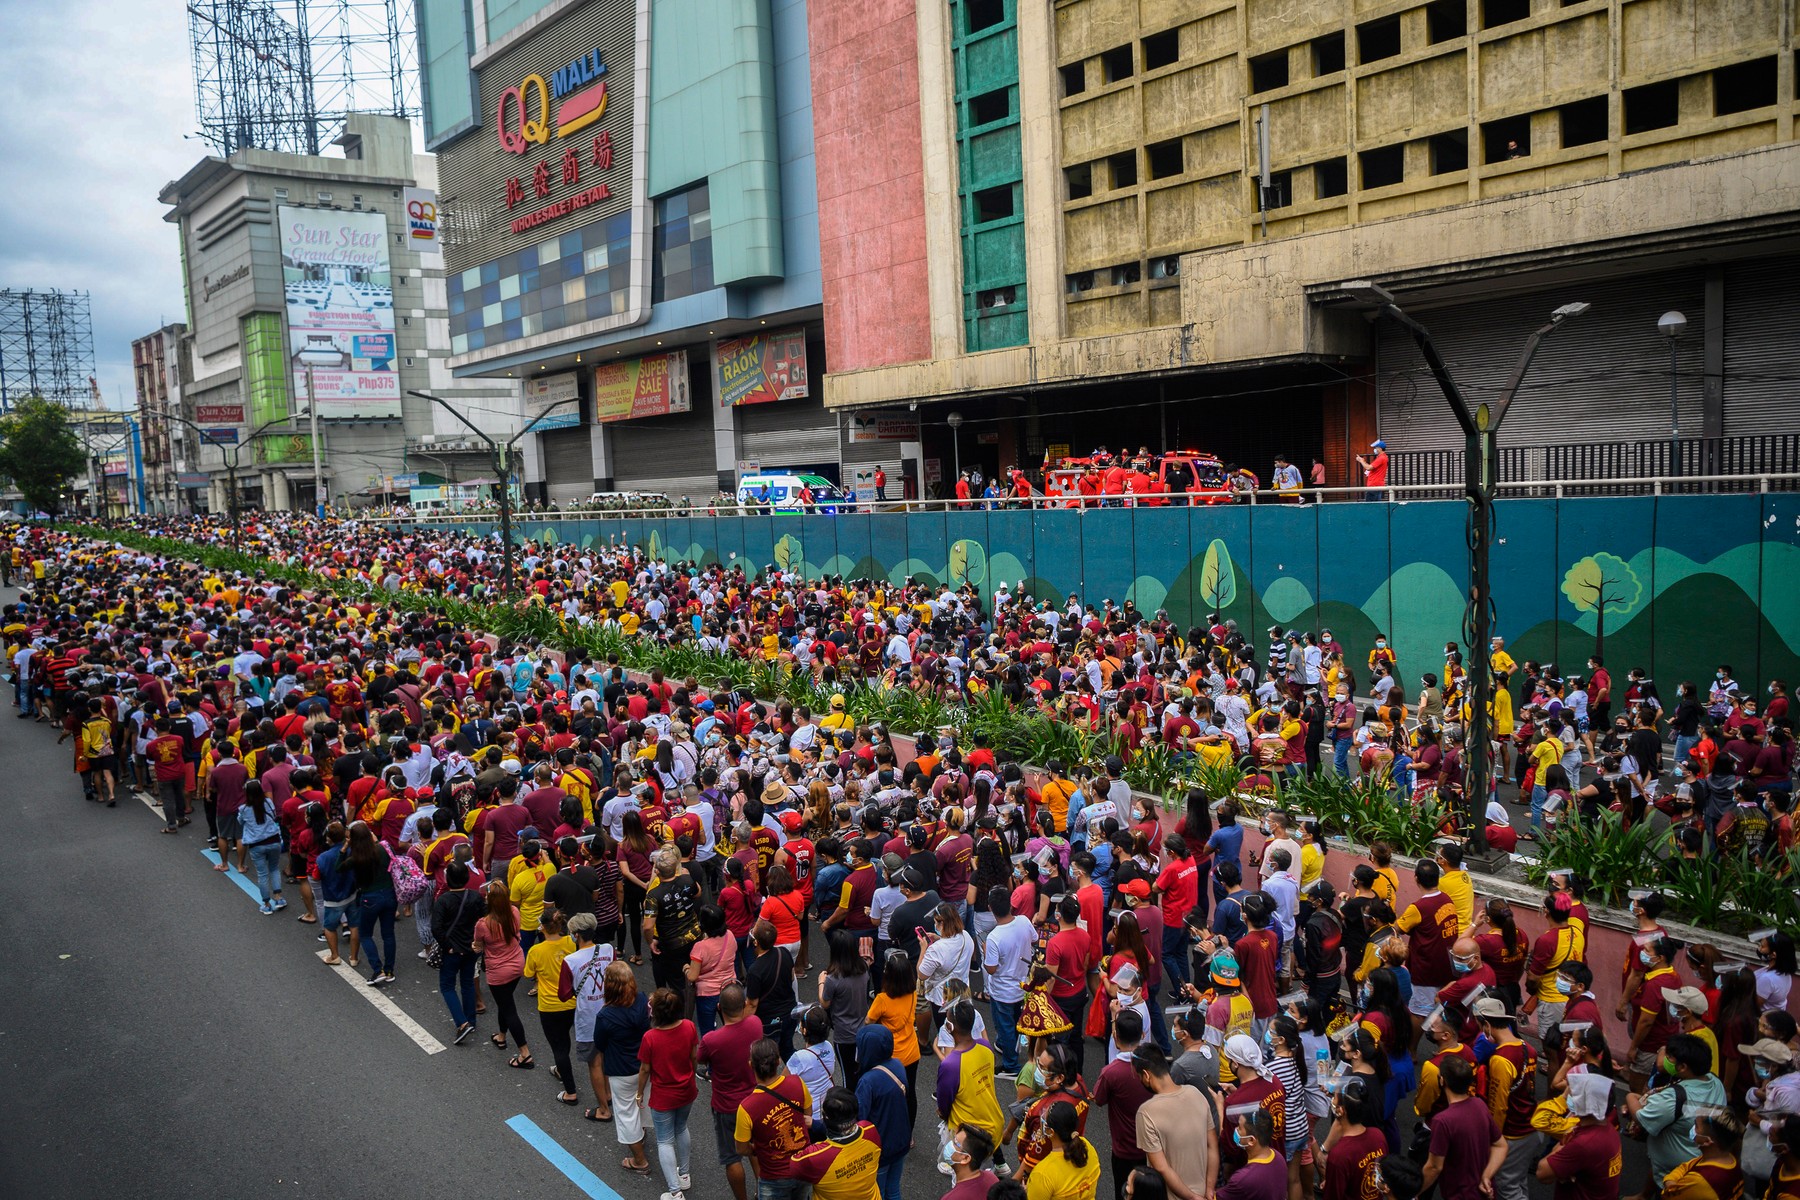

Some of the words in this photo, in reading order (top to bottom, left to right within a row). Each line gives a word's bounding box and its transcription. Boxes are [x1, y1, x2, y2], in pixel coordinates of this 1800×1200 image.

[497, 73, 550, 155] QQ
[551, 47, 607, 100] MALL
[504, 130, 614, 211] 批發商場
[408, 200, 436, 222] QQ
[410, 221, 435, 230] MALL
[289, 223, 331, 245] Sun
[335, 226, 382, 248] Star
[291, 247, 340, 263] Grand
[339, 250, 381, 265] Hotel
[640, 359, 668, 379] SUPER
[723, 348, 759, 382] RAON
[358, 377, 395, 389] Php375
[640, 377, 662, 395] SALE
[721, 374, 750, 395] Electronics
[750, 367, 762, 377] Hub
[634, 398, 647, 407] SAVE
[647, 395, 662, 405] MORE
[652, 405, 666, 413] Price
[199, 406, 219, 416] Sun
[220, 406, 242, 416] Star
[878, 421, 918, 433] CARPARK
[846, 1165, 867, 1179] CHAPTER
